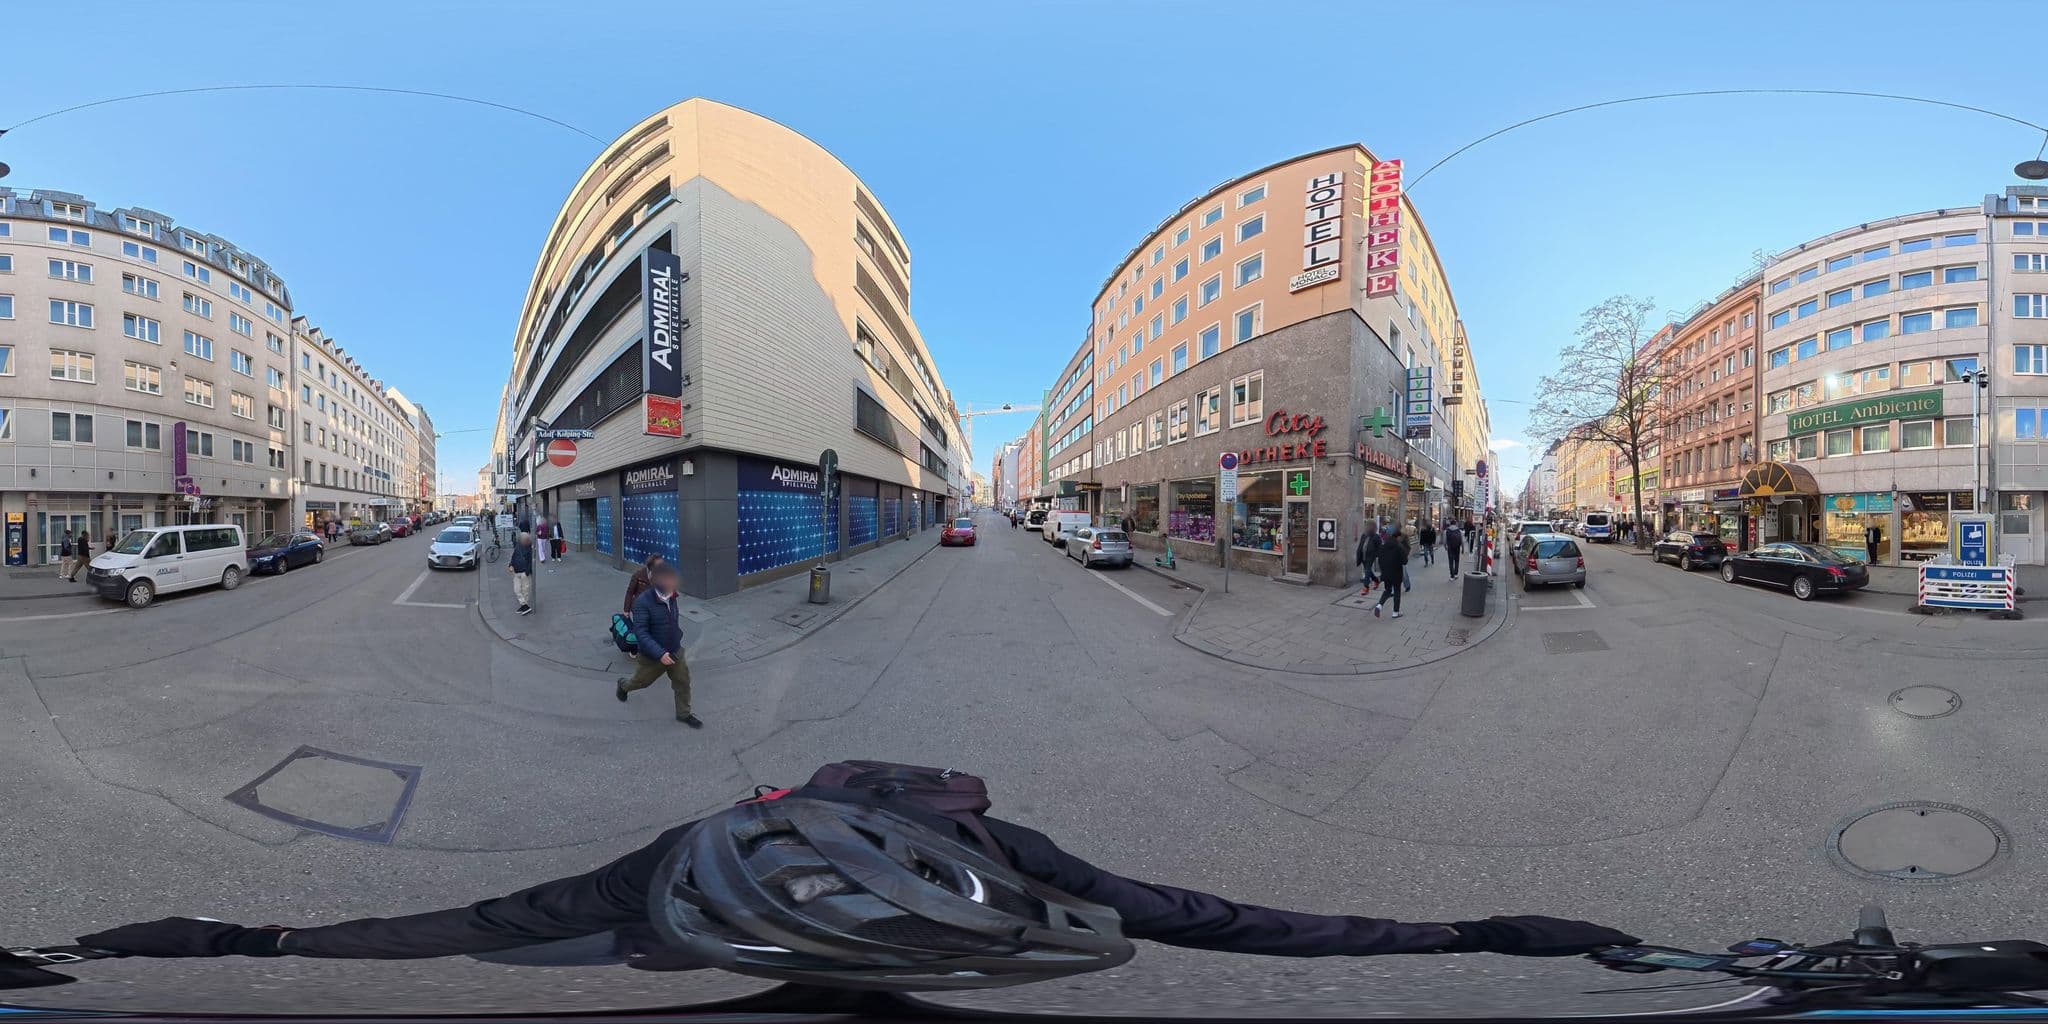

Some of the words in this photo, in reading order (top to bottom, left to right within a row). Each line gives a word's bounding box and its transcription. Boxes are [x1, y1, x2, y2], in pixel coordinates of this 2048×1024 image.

[1310, 173, 1335, 265] HOTEL
[1369, 161, 1400, 294] APOTHEKE
[1290, 269, 1337, 288] MONACO
[1297, 268, 1329, 281] HOTEL
[651, 266, 672, 371] ADMIRAL
[671, 278, 679, 350] SPIELHALLE
[1454, 336, 1463, 393] HOTEL
[1415, 368, 1423, 411] Lyca
[1265, 408, 1324, 437] City
[1793, 410, 1842, 430] HOTEL
[1851, 398, 1935, 419] Ambiente
[1217, 439, 1327, 466] OTHEKE
[625, 466, 674, 485] ADMIRAL
[633, 480, 667, 489] SPIELHALLE
[783, 481, 816, 489] SPIELHALLE
